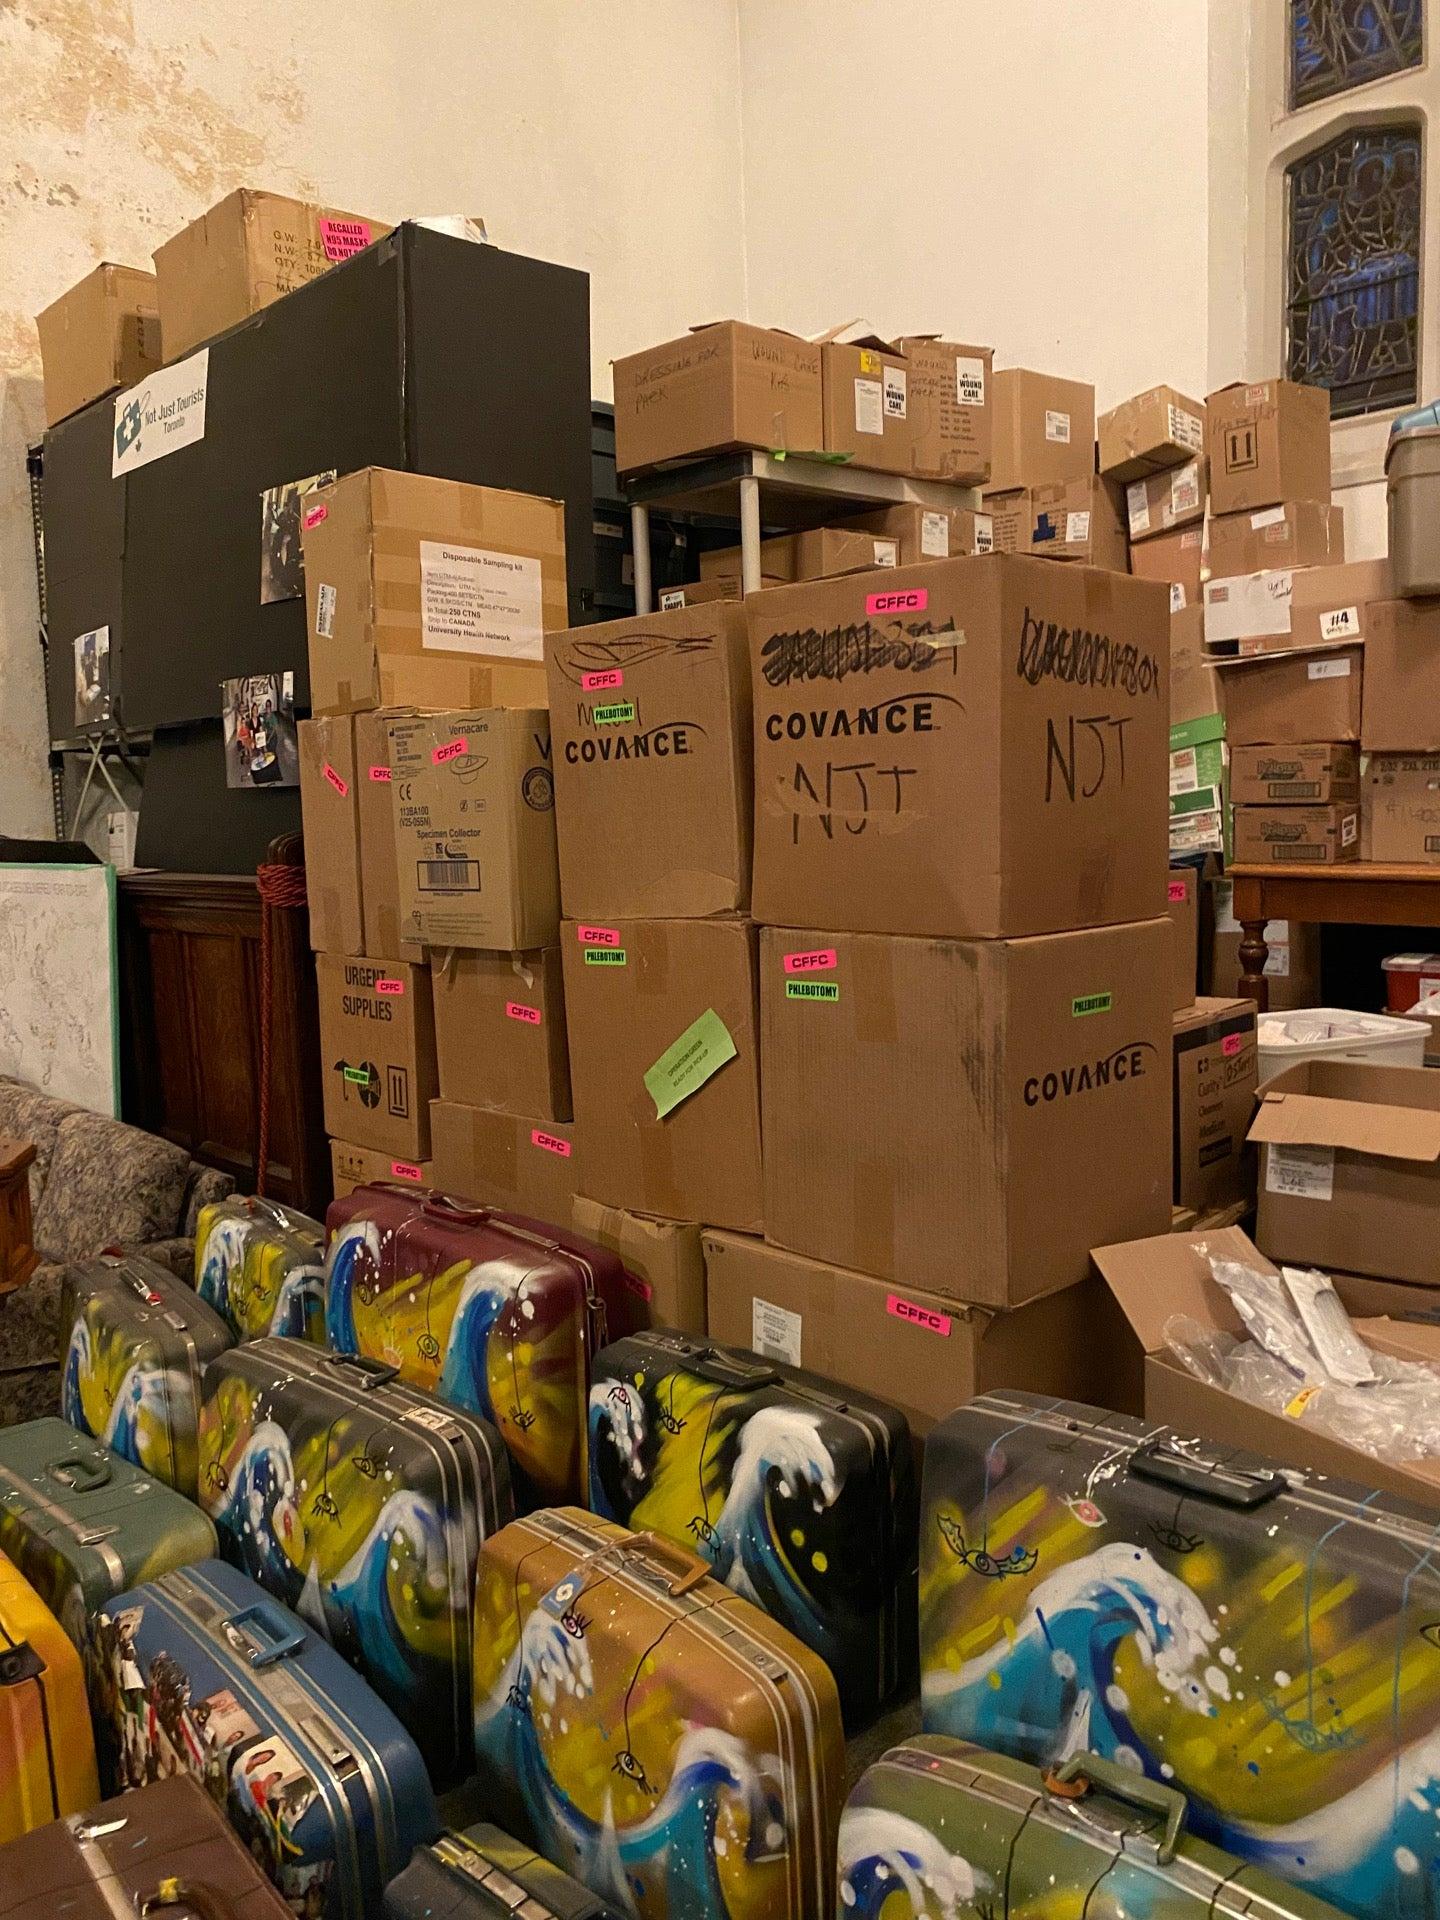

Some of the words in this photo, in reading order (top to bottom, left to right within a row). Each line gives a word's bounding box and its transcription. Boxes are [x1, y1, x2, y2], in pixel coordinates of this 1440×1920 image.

[328, 222, 363, 235] RECALLED
[342, 236, 369, 247] MASKS
[327, 246, 337, 257] DO
[338, 247, 352, 258] NOT
[959, 379, 982, 390] WOUND
[886, 389, 905, 401] WOUND
[963, 389, 979, 399] CARE
[145, 408, 157, 426] Not
[158, 400, 176, 420] Just
[176, 387, 205, 413] Tourists
[888, 400, 902, 411] CARE
[164, 415, 186, 434] Toronto
[442, 551, 482, 564] Disposable
[483, 557, 514, 571] Sampling
[514, 561, 523, 572] kit
[875, 594, 919, 610] CFFC
[462, 610, 481, 619] CTNS
[448, 618, 476, 627] CANADA
[428, 625, 462, 637] University
[485, 631, 512, 642] Network
[588, 674, 617, 687] CFFC
[595, 706, 633, 721] PHLEBOTOMY
[449, 723, 489, 735] Vernacare
[765, 702, 934, 741] COVANCE
[437, 743, 462, 760] CFFC
[565, 730, 688, 764] COVANCE
[1045, 715, 1133, 803] NJT
[792, 762, 918, 844] NJT
[417, 829, 447, 839] Specimen
[449, 828, 481, 838] Collector
[584, 931, 613, 943] CFFC
[586, 951, 625, 963] PHLEBOTOMY
[791, 954, 829, 969] CFFC
[380, 982, 400, 992] CFFC
[788, 983, 838, 998] PHLEBOTOMY
[342, 995, 392, 1022] SUPPLIES
[511, 1006, 536, 1021] CFFC
[1023, 1051, 1143, 1106] COVANCE
[537, 1135, 566, 1153] CFFC
[395, 1165, 418, 1178] CFFC
[896, 1302, 941, 1328] CFFC
